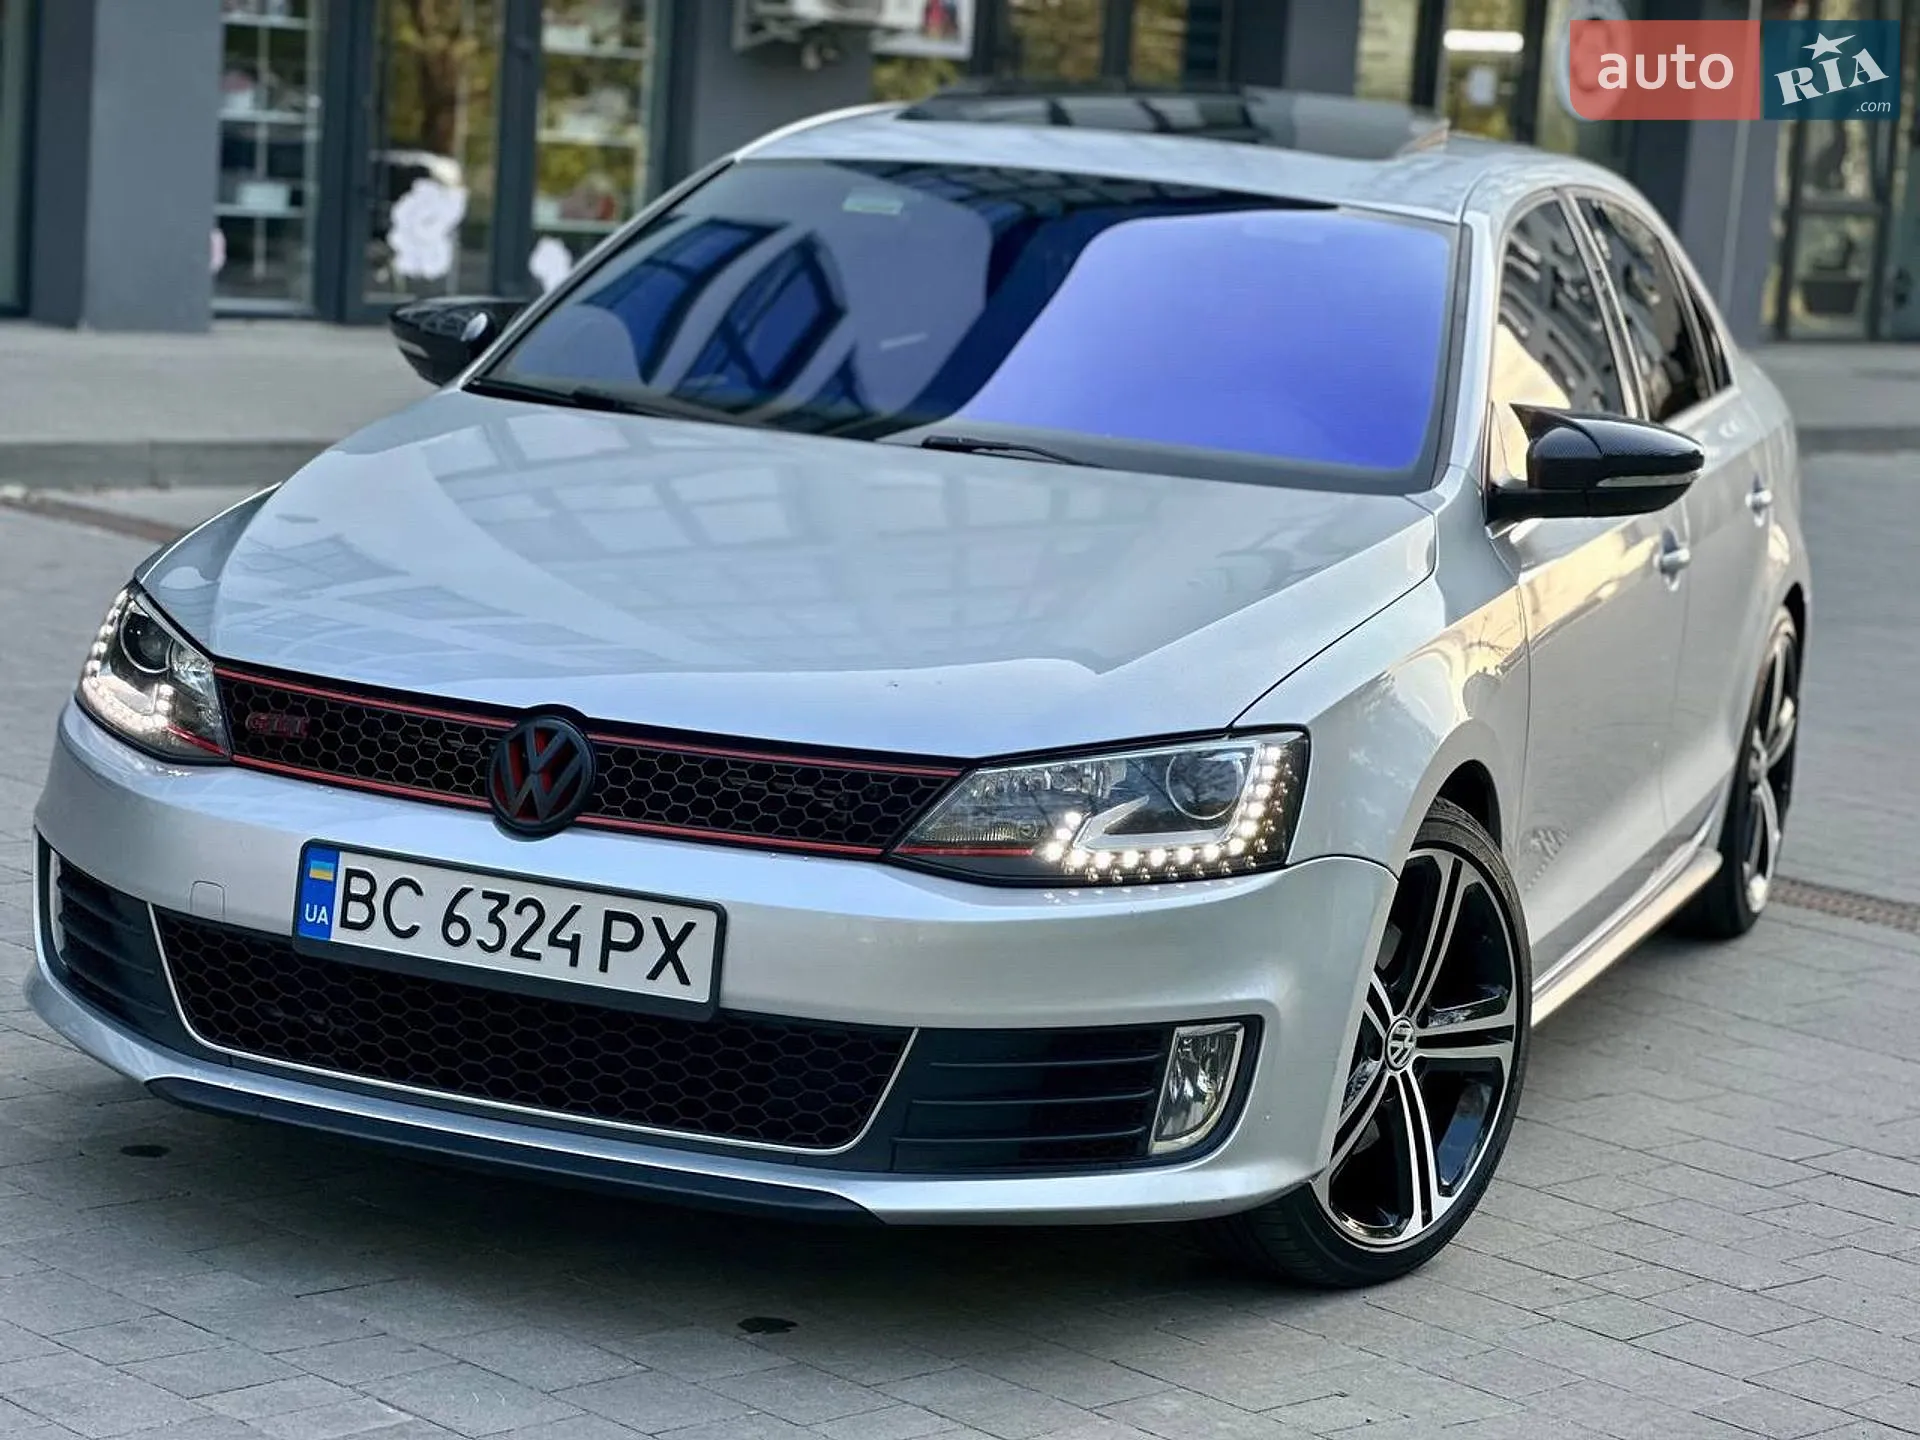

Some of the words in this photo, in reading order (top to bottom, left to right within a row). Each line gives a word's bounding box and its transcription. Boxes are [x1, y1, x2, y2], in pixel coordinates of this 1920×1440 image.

[304, 903, 329, 926] UA
[339, 867, 424, 939] BC
[441, 886, 583, 968] 6324
[598, 909, 697, 986] PX
